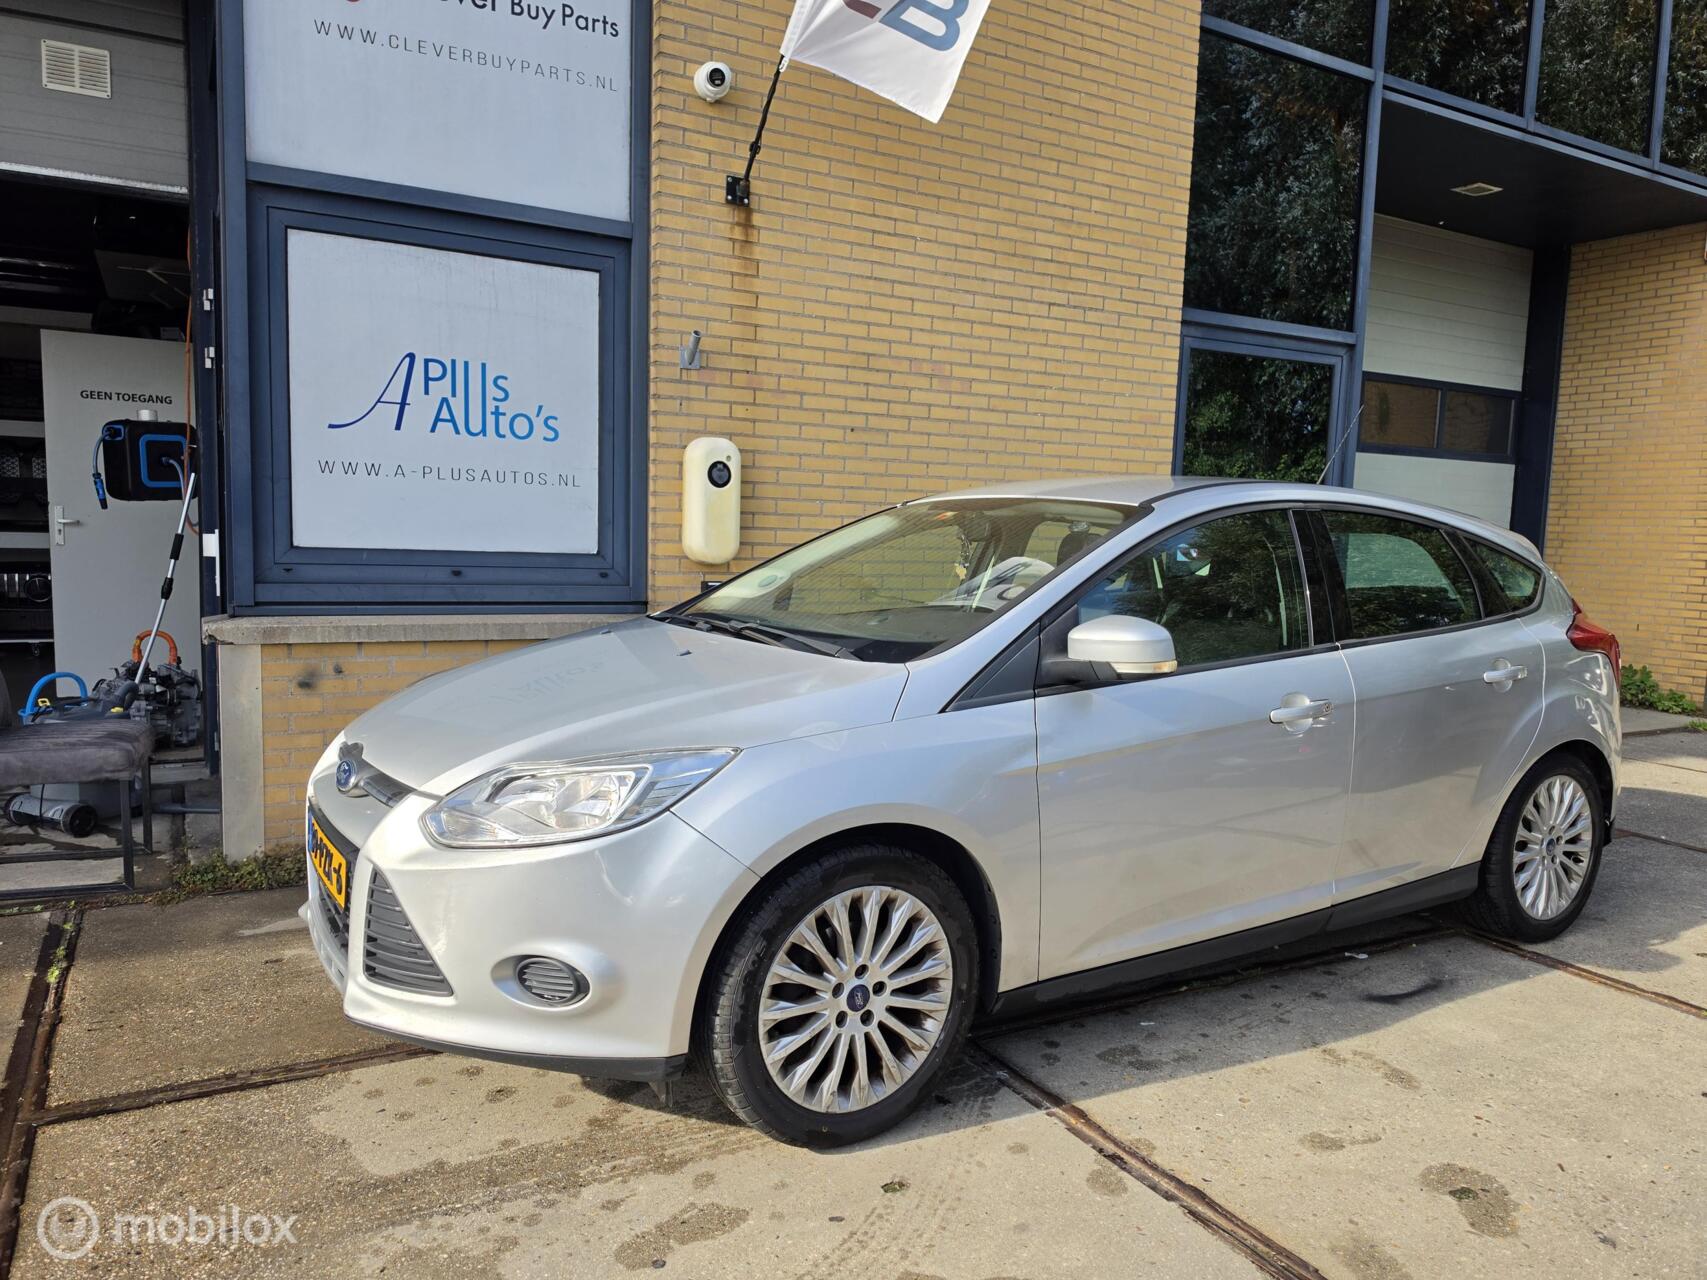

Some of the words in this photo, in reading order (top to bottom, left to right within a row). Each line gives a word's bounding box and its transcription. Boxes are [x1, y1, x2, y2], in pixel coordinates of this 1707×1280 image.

[510, 0, 556, 30] Buy
[561, 3, 620, 38] Parts
[313, 18, 619, 92] WWW.CLEVERBUYPARTS.NL
[80, 389, 113, 401] GEEN
[115, 392, 173, 405] TOEGANG
[327, 351, 416, 431] A
[317, 459, 582, 488] WWW.A-PLUSAUTOS.NL
